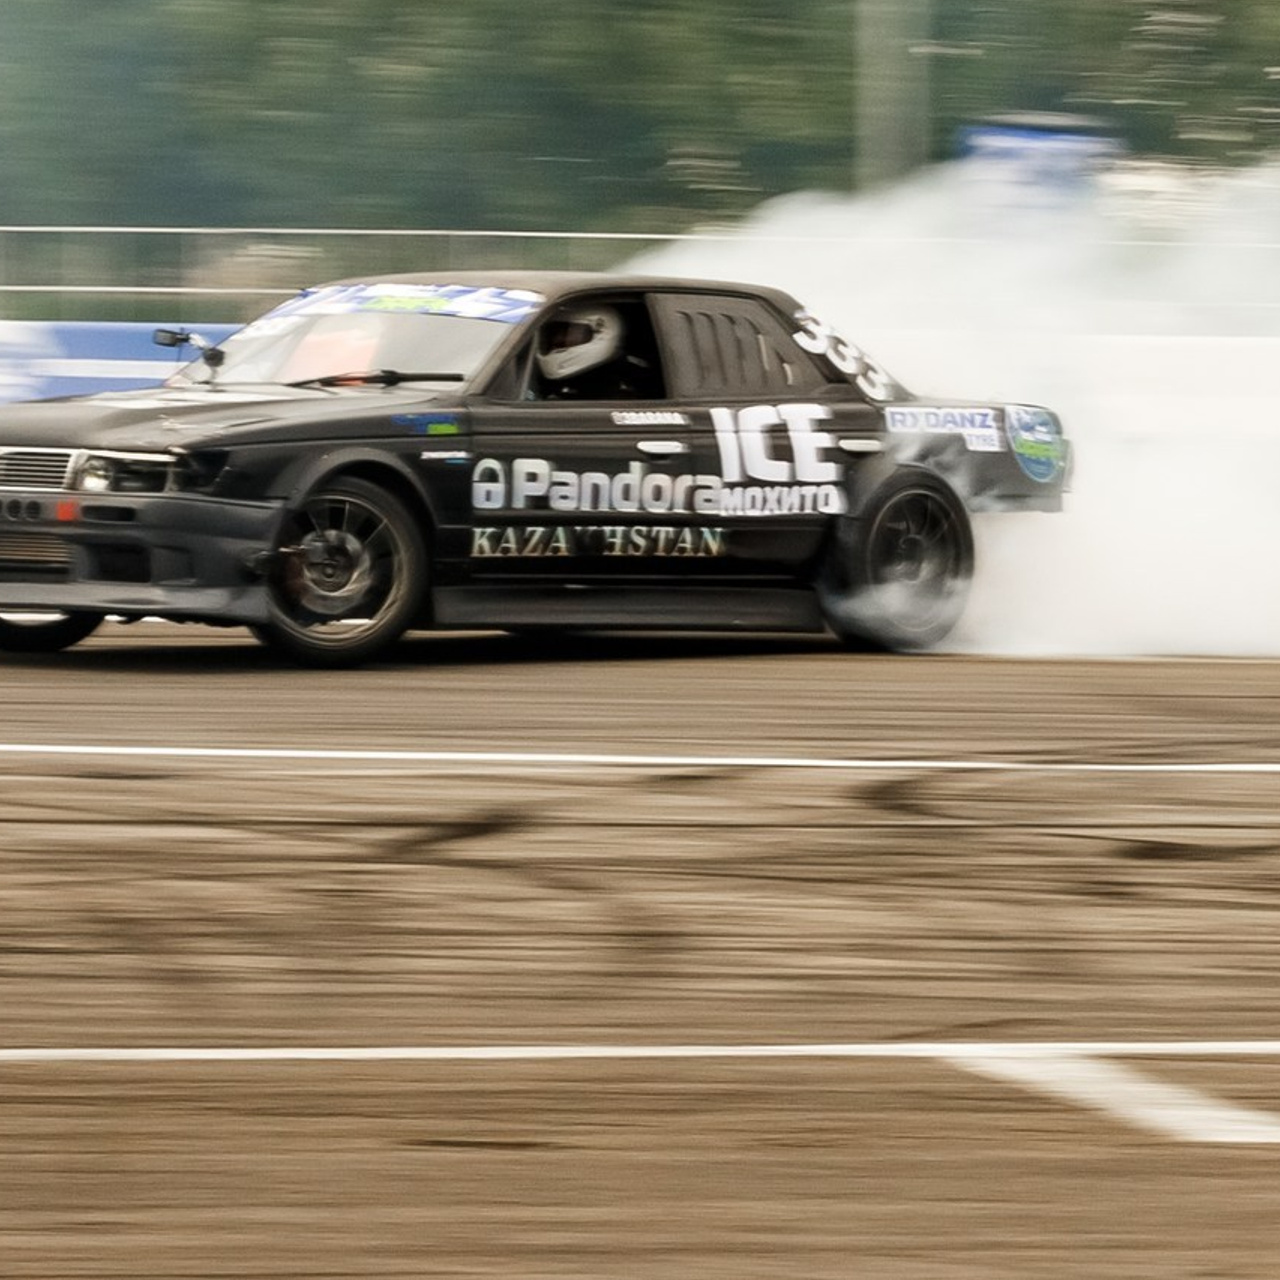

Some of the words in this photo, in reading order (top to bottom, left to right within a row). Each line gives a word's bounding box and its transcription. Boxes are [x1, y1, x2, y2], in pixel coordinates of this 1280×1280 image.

[709, 403, 843, 483] ICE
[511, 458, 723, 514] Pandora
[470, 525, 725, 557] KAZAHSTAN
